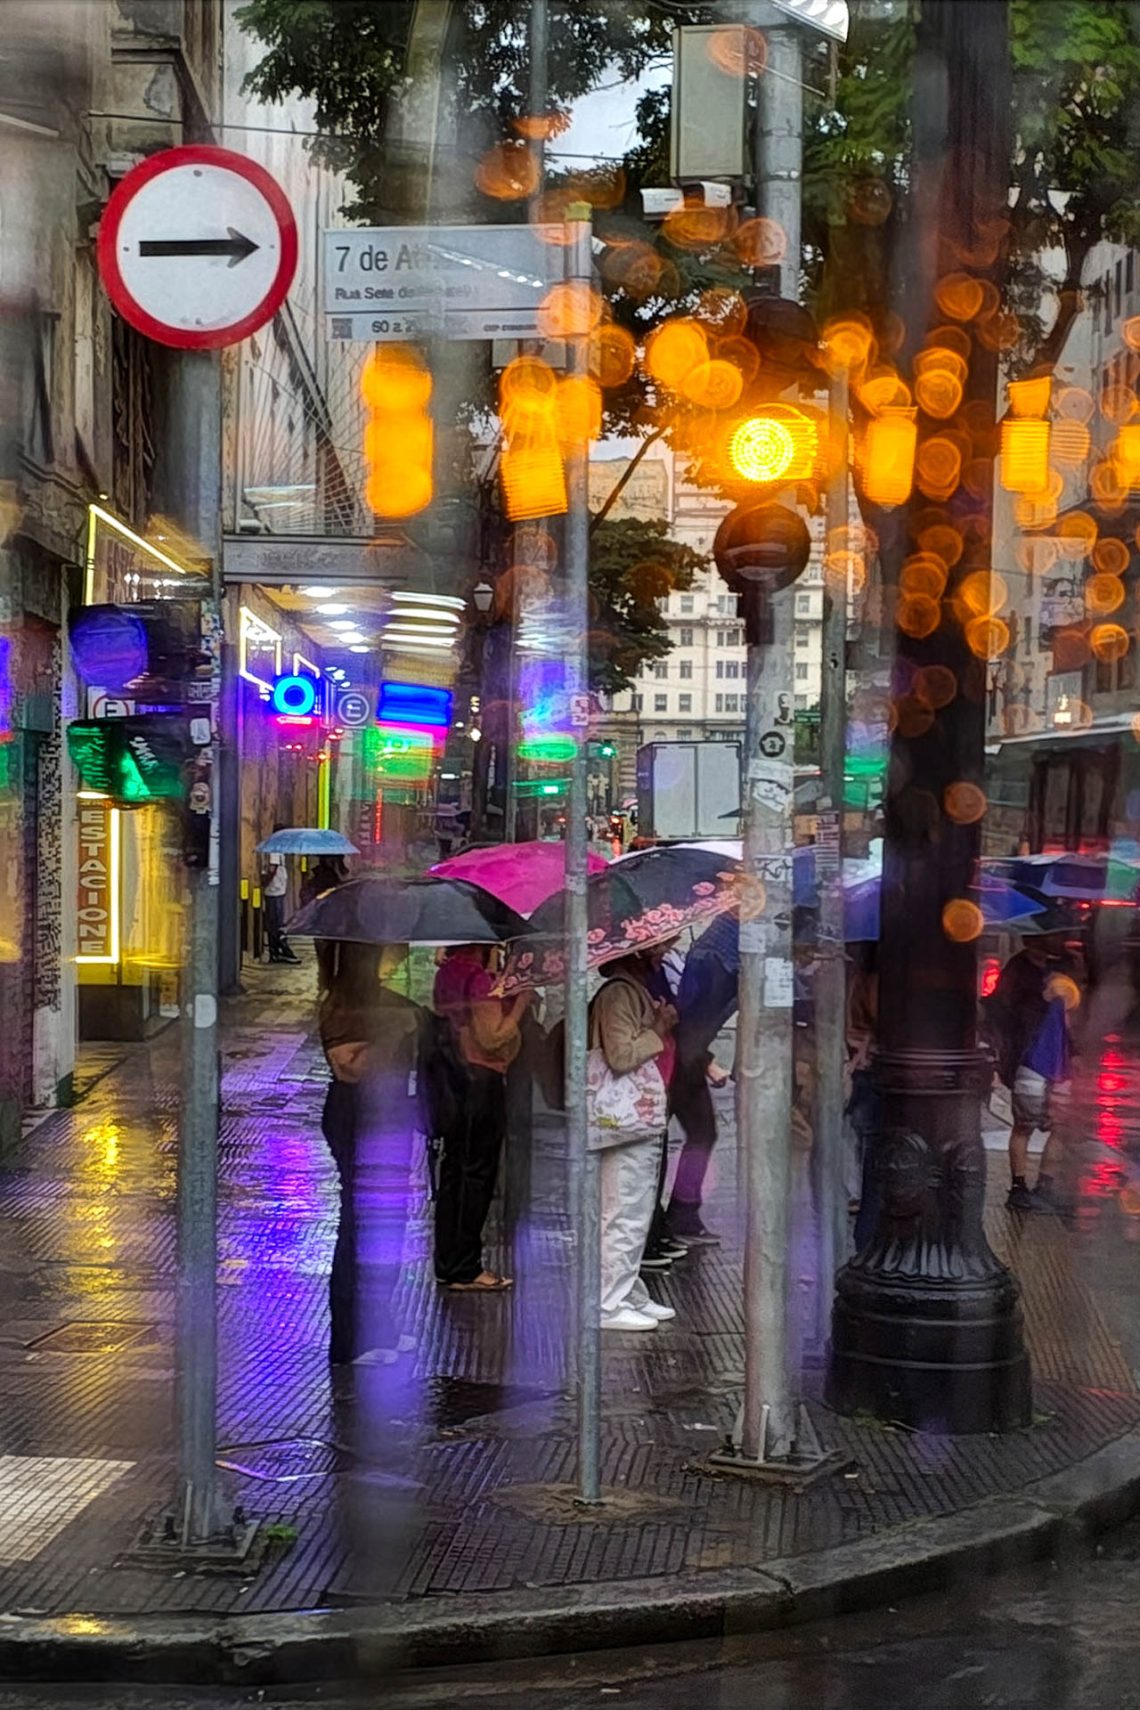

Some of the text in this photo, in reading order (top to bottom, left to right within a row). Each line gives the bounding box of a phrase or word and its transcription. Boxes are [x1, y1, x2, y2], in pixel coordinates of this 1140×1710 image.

[335, 246, 350, 272] 7
[360, 245, 389, 271] de
[335, 288, 362, 300] Rua
[79, 810, 107, 953] ESTACIONE
